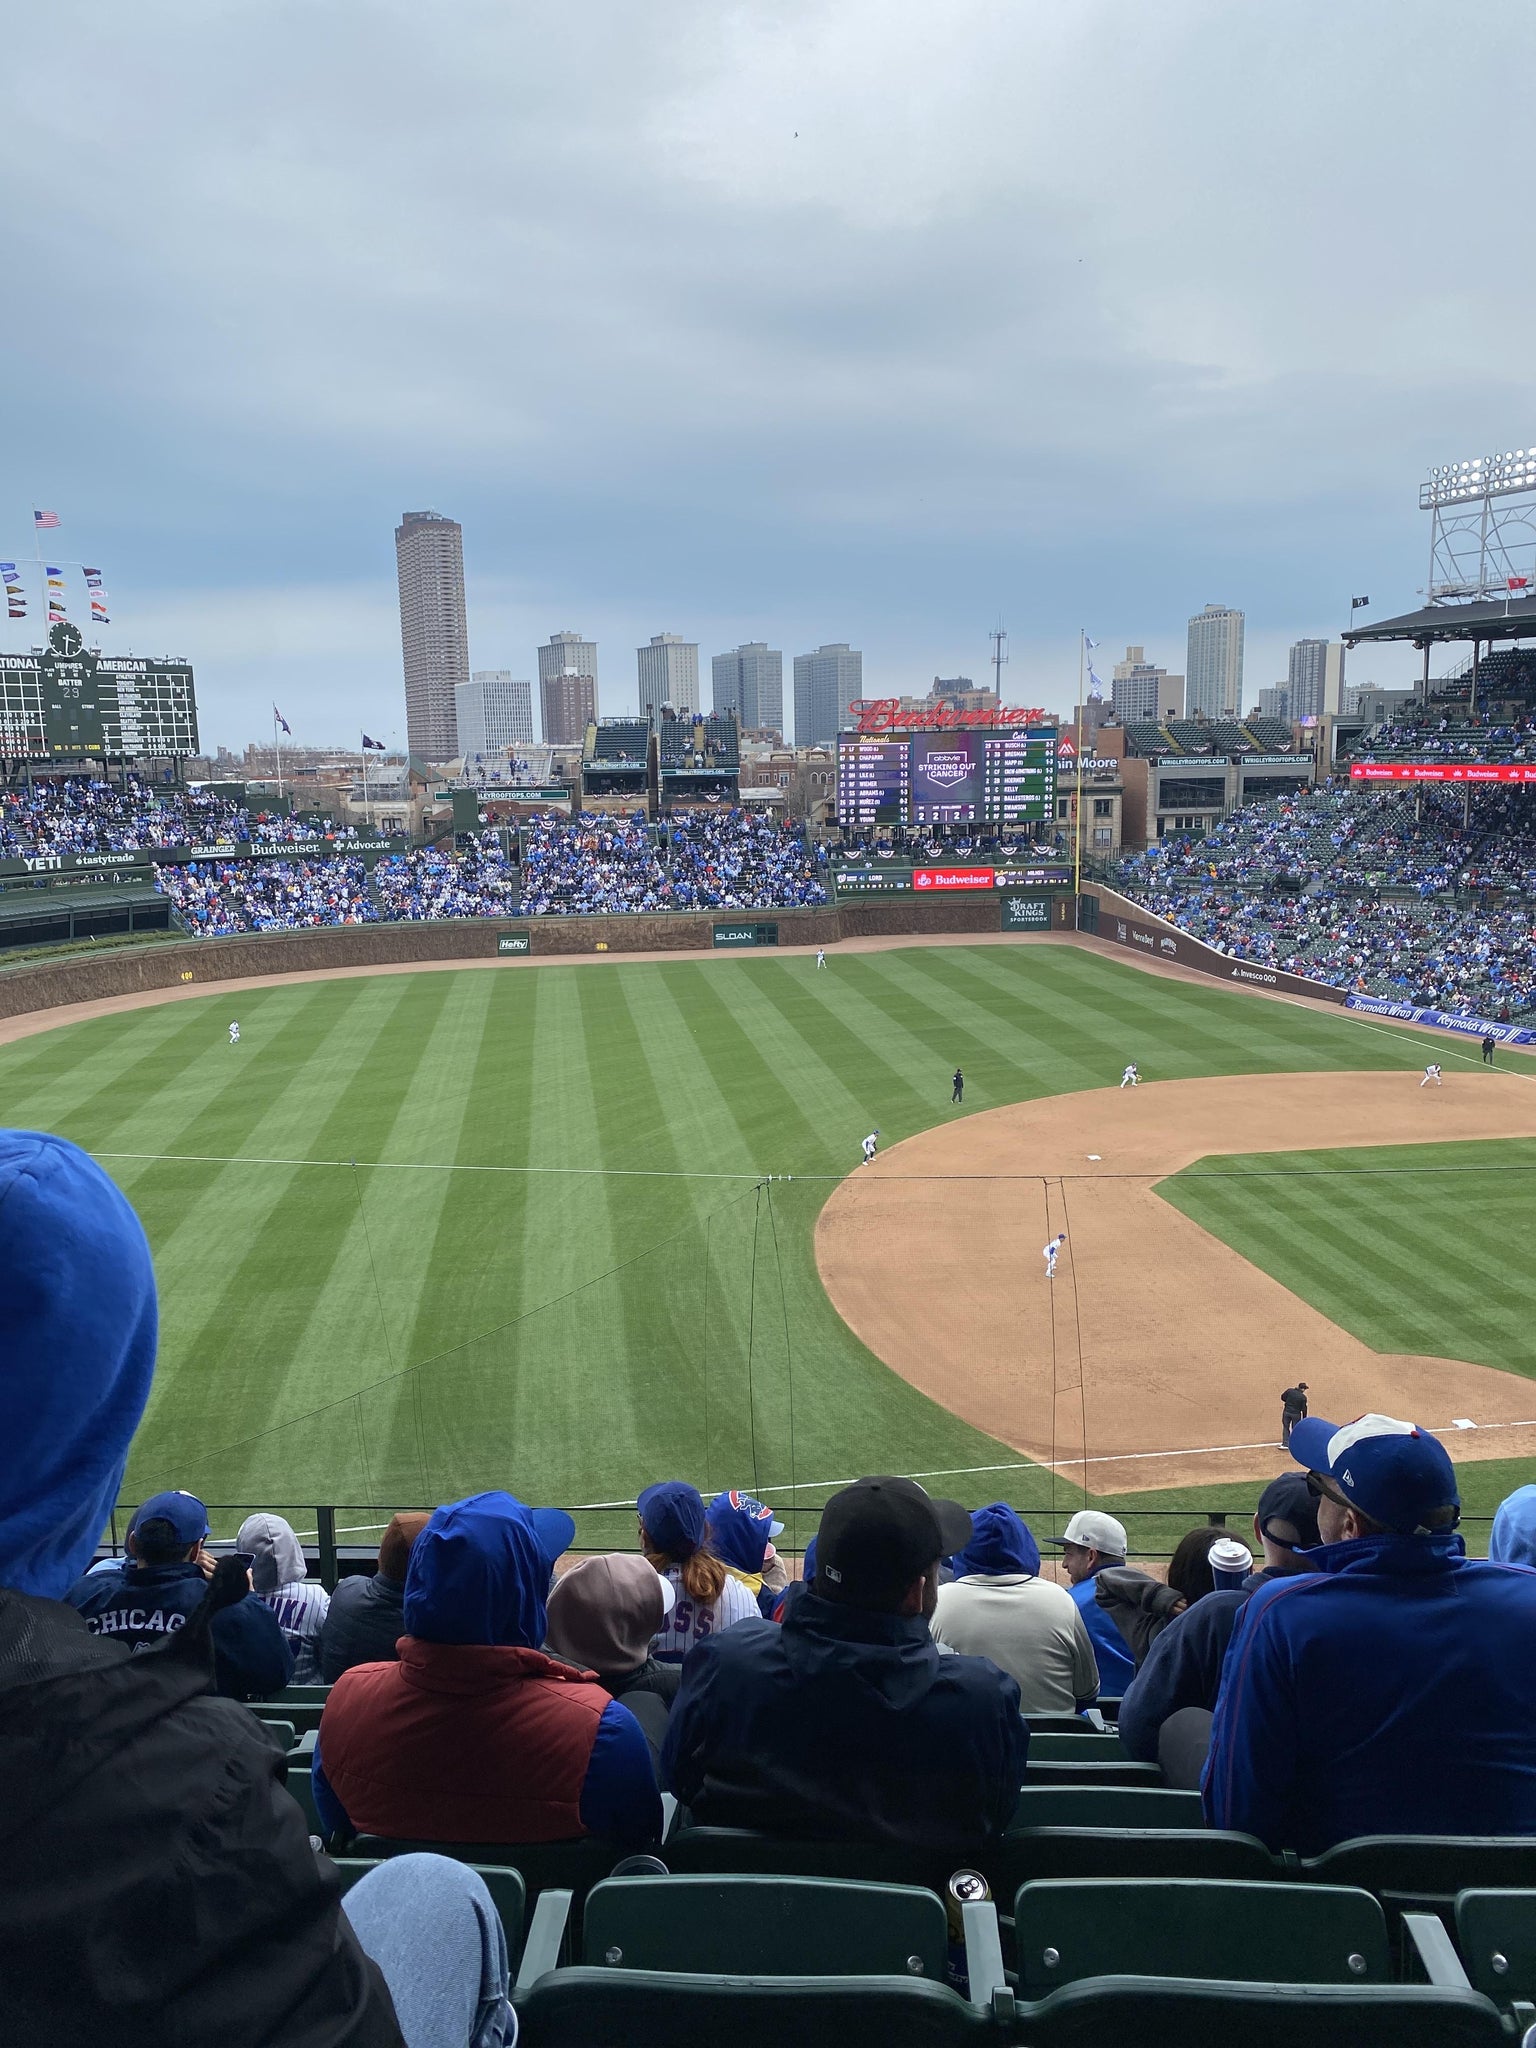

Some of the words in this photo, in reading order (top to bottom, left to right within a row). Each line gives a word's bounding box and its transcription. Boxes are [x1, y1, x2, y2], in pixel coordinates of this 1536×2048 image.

[0, 658, 41, 669] TIONAL
[96, 660, 147, 671] AMERICAN
[63, 687, 79, 698] 29
[849, 698, 1045, 731] Budweiser
[860, 735, 890, 743] Nationals
[1013, 731, 1027, 739] Cubs
[1077, 757, 1118, 769] Moore
[1245, 756, 1309, 764] WRIGLEYROOFTOPS.COM
[1414, 769, 1444, 777] Budweiser
[1467, 769, 1499, 778] Budweiser
[918, 812, 925, 820] 2
[932, 812, 939, 820] 2
[954, 811, 960, 819] 2
[968, 811, 975, 819] 3
[190, 845, 236, 854] GRAINGER
[346, 841, 390, 850] Advocate
[23, 856, 62, 871] YETI
[83, 853, 134, 865] tastytrade
[935, 874, 990, 885] Budweiser
[1010, 903, 1045, 911] DRAFT
[715, 932, 752, 940] SLOAN
[502, 941, 526, 949] Hefty
[181, 971, 193, 980] 400
[1240, 969, 1263, 980] Invesco
[1264, 974, 1277, 983] QQQ
[1352, 1000, 1389, 1016] Reynolds
[1388, 1005, 1411, 1019] Wrap
[1436, 1014, 1479, 1031] Reynolds
[1478, 1022, 1506, 1038] Wrap
[258, 1597, 307, 1630] UKI
[85, 1608, 186, 1635] CHICAG
